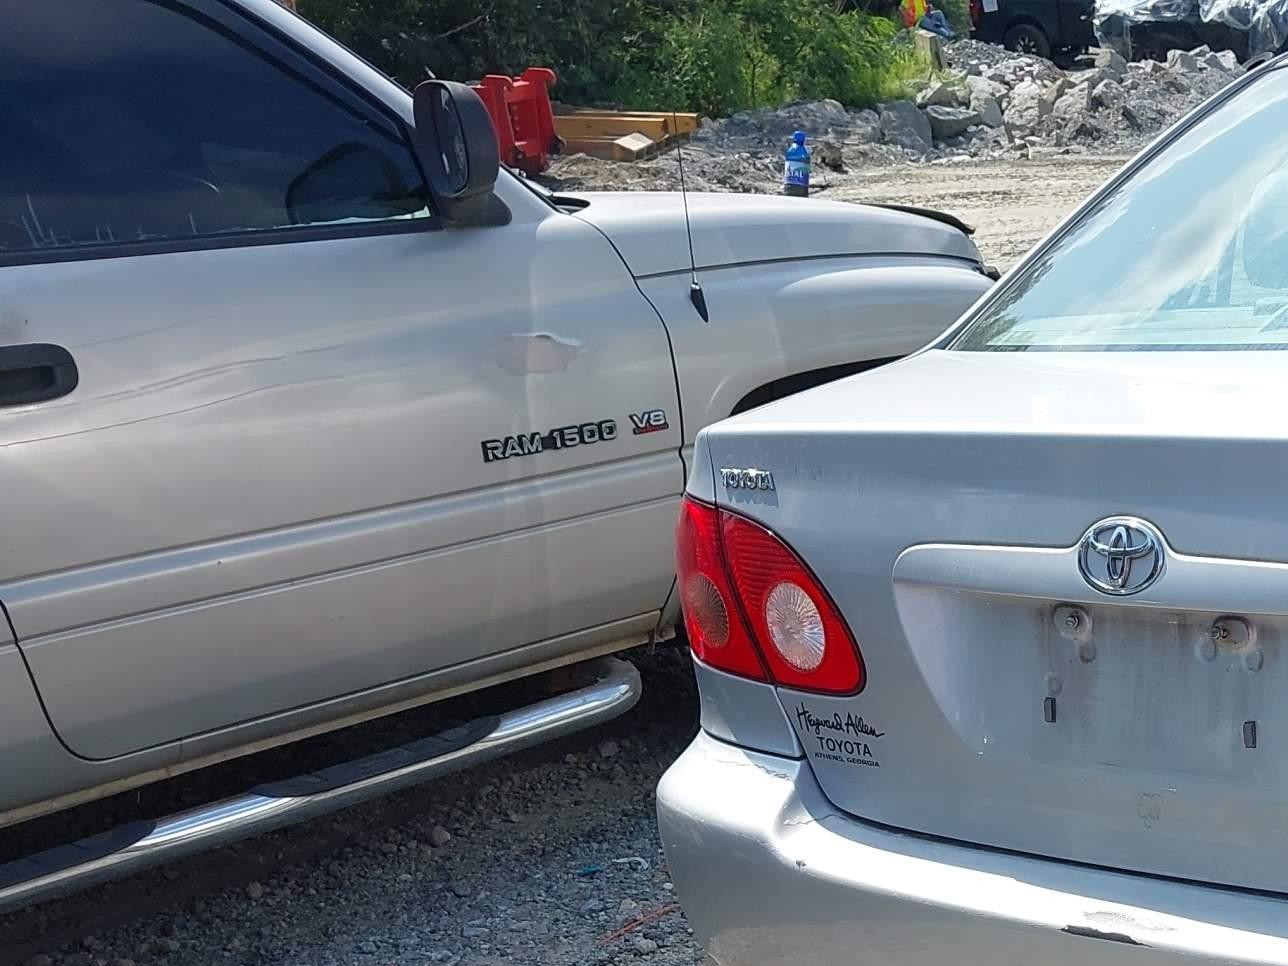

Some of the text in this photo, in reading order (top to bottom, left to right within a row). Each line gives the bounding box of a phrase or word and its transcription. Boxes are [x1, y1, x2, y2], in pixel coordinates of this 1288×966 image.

[482, 409, 667, 463] RAM 1500 V8
[720, 467, 776, 491] TOYOTA
[845, 712, 885, 738] Allen
[817, 736, 873, 757] TOYOTA
[846, 757, 880, 768] GEORGIA
